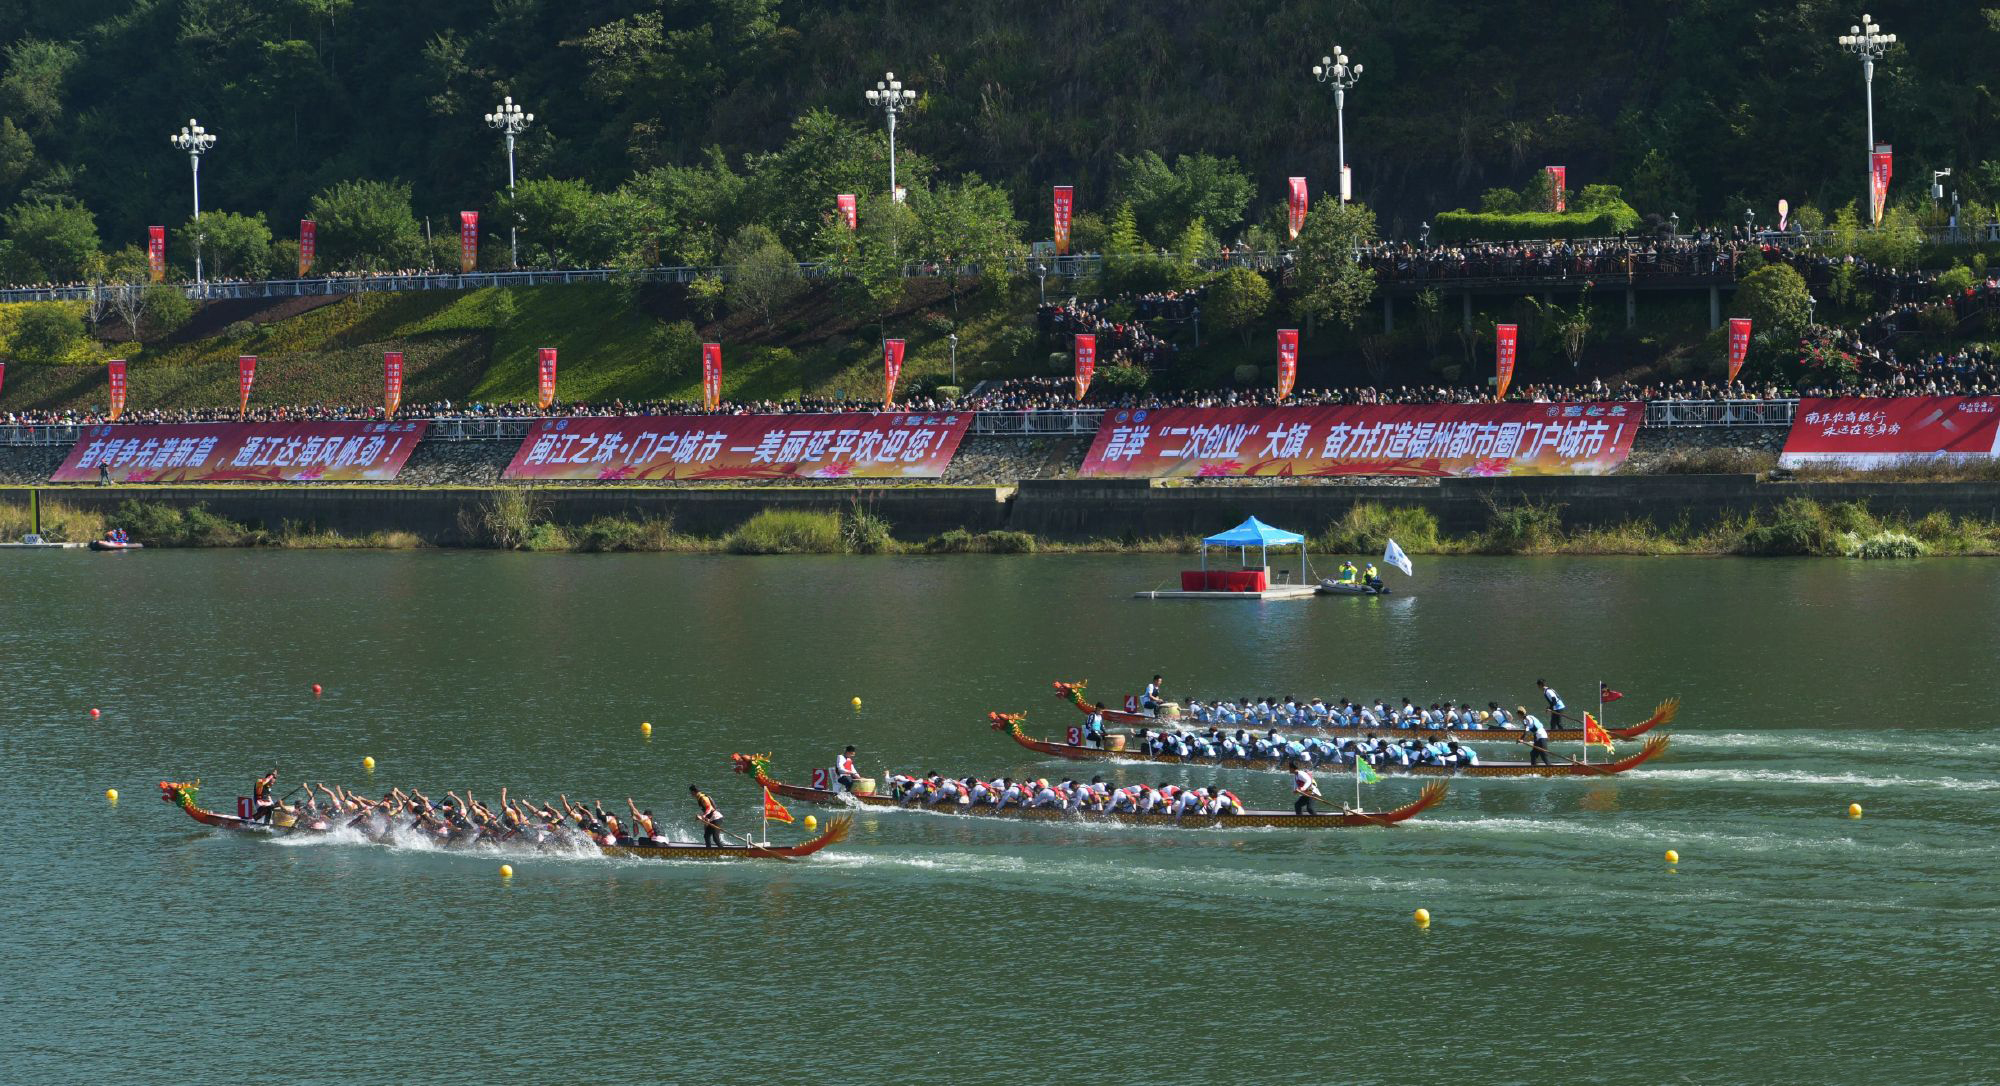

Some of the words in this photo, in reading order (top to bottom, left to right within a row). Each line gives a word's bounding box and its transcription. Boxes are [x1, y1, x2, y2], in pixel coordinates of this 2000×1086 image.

[1125, 696, 1136, 711] 4
[1068, 727, 1079, 745] 3
[814, 769, 825, 789] 2
[241, 798, 250, 818] 1
